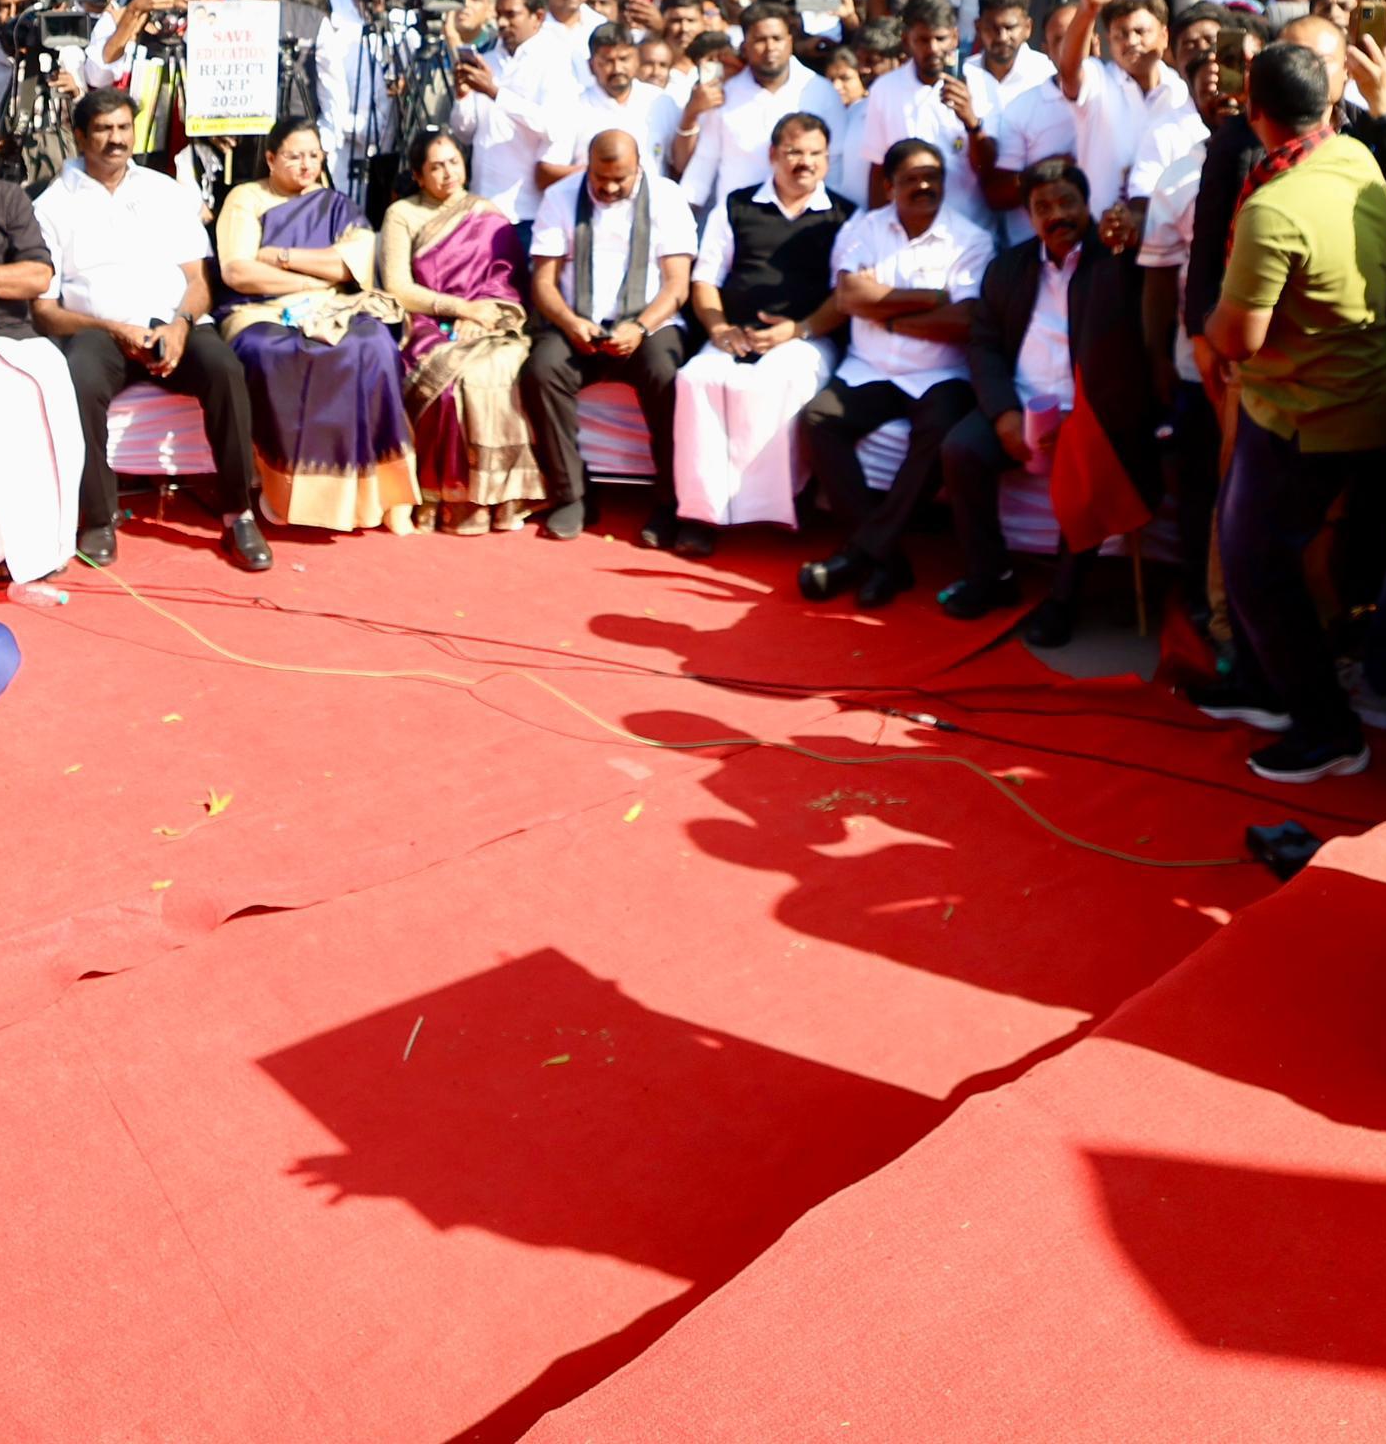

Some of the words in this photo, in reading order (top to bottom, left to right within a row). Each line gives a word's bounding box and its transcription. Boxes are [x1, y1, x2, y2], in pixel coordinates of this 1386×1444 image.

[213, 30, 253, 43] SAVE
[200, 63, 265, 77] REJECT
[217, 78, 250, 92] NEP
